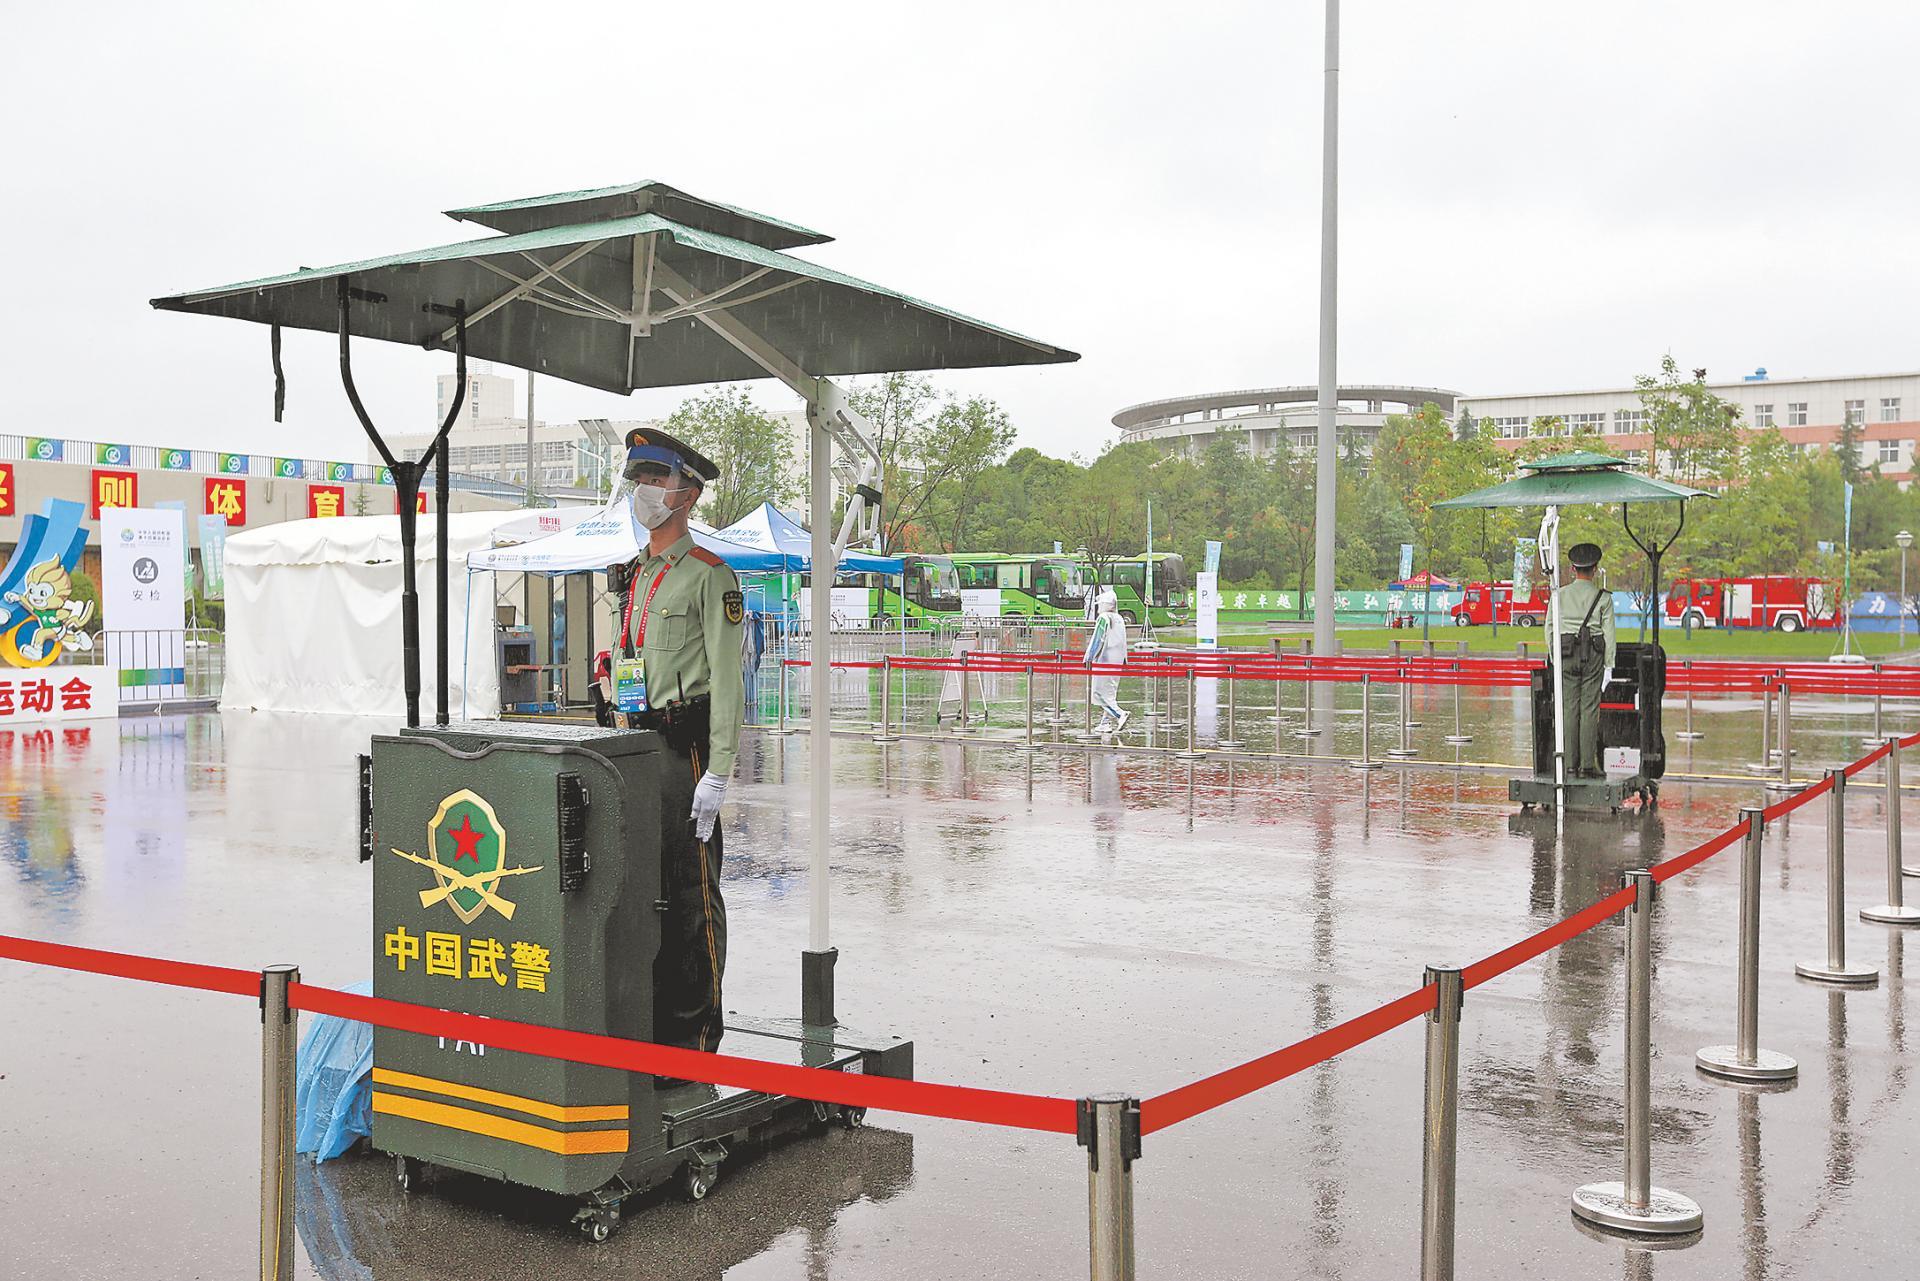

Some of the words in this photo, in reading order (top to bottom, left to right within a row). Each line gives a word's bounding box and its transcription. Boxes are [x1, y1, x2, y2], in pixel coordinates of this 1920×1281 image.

[132, 589, 161, 602] 安检
[384, 926, 551, 993] 中国武警
